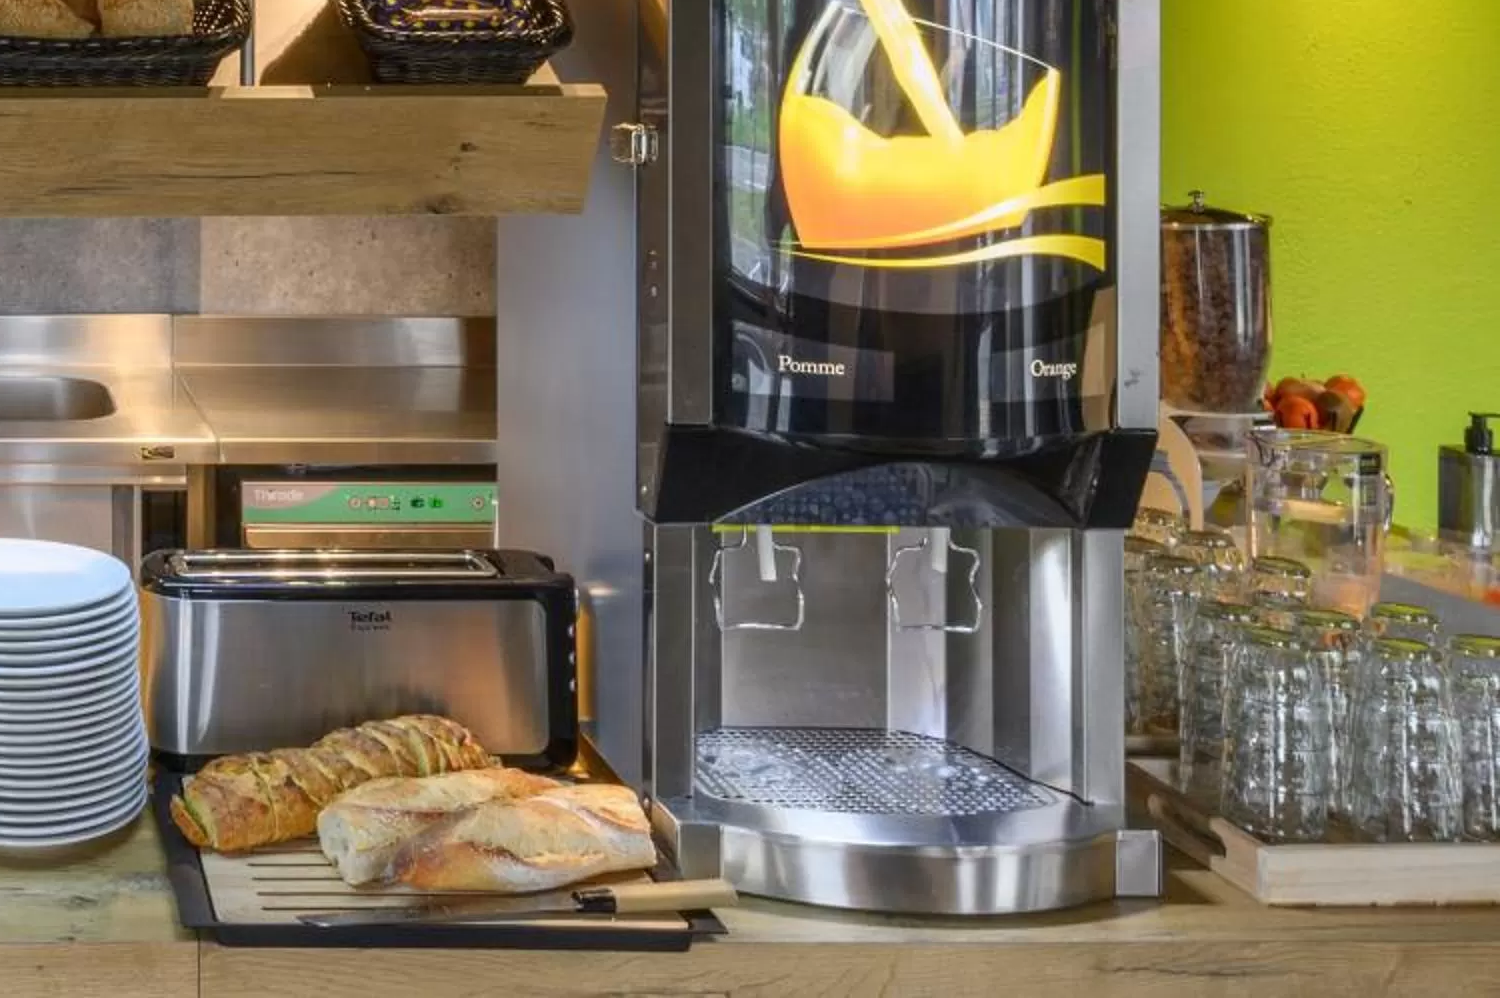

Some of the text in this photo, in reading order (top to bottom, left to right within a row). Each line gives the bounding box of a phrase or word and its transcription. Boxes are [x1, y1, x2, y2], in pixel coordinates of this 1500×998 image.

[778, 355, 845, 376] Pomme
[1029, 359, 1077, 379] Orange
[348, 611, 393, 623] Tefal
